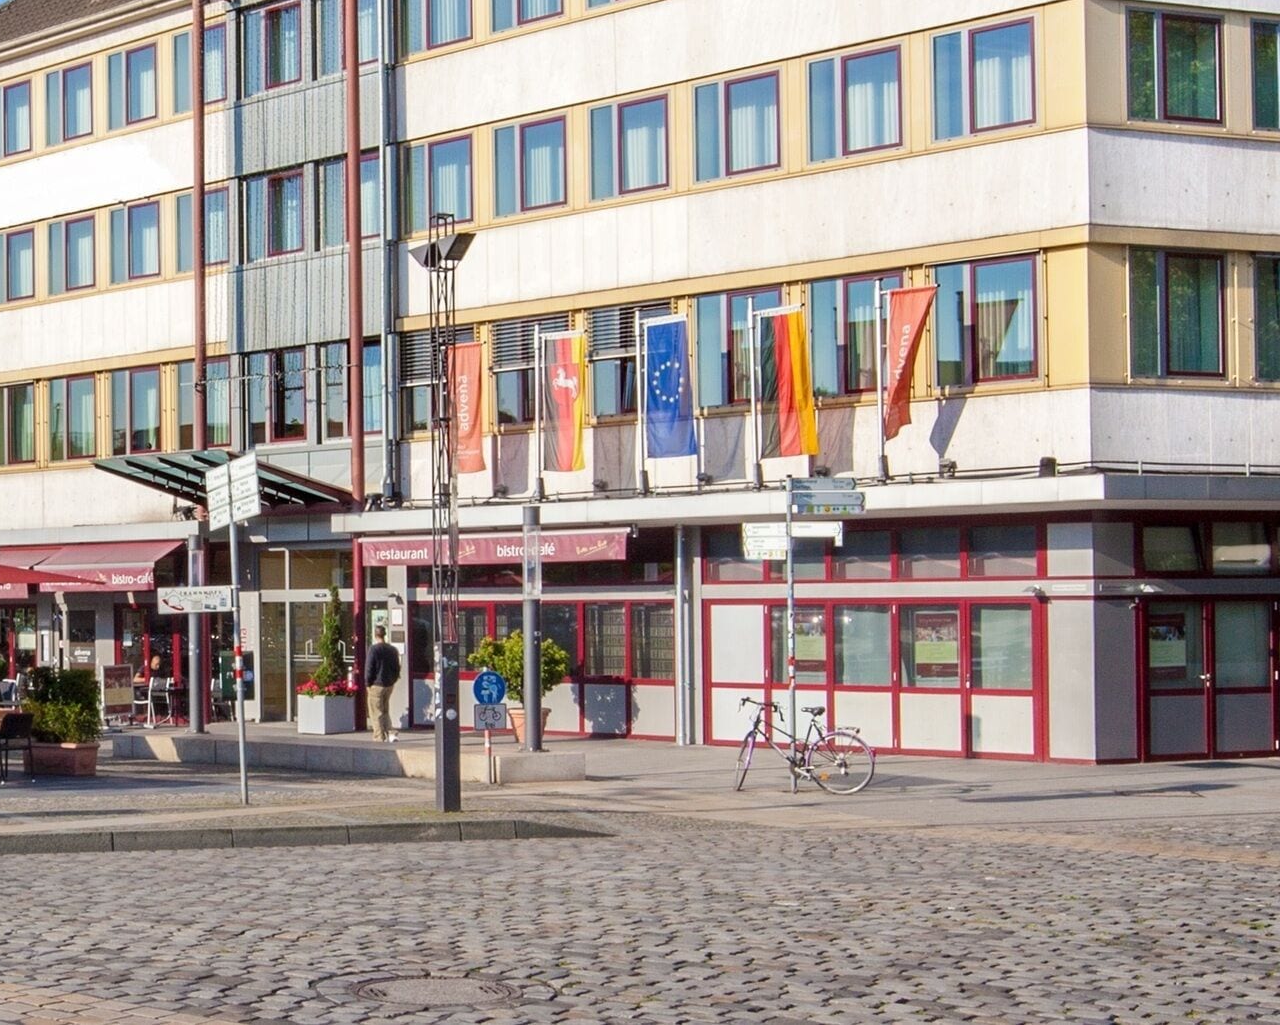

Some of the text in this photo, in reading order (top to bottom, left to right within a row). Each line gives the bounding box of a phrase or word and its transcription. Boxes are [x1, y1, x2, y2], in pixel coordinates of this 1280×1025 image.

[892, 324, 912, 380] dvena
[458, 375, 469, 432] advena
[376, 547, 428, 561] restaurant
